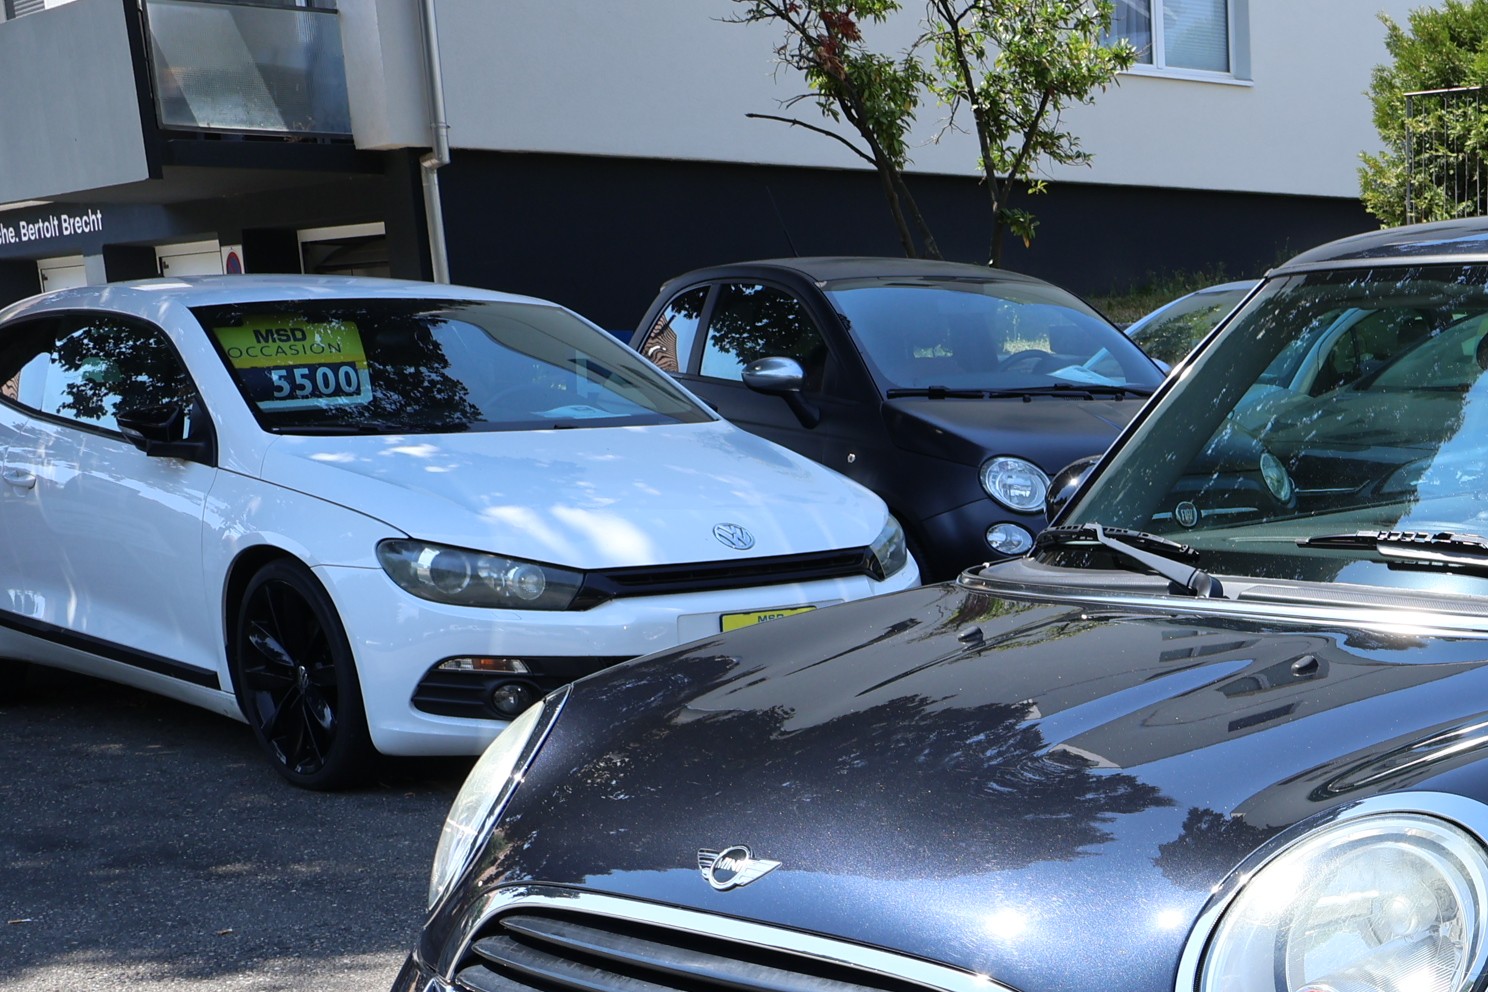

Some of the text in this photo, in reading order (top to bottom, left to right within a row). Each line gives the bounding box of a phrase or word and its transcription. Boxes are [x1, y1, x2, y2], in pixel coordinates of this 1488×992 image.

[0, 208, 103, 245] he. Bertolt Brecht
[253, 327, 308, 344] MSD
[227, 342, 342, 359] OCCASION
[270, 365, 359, 398] 5500
